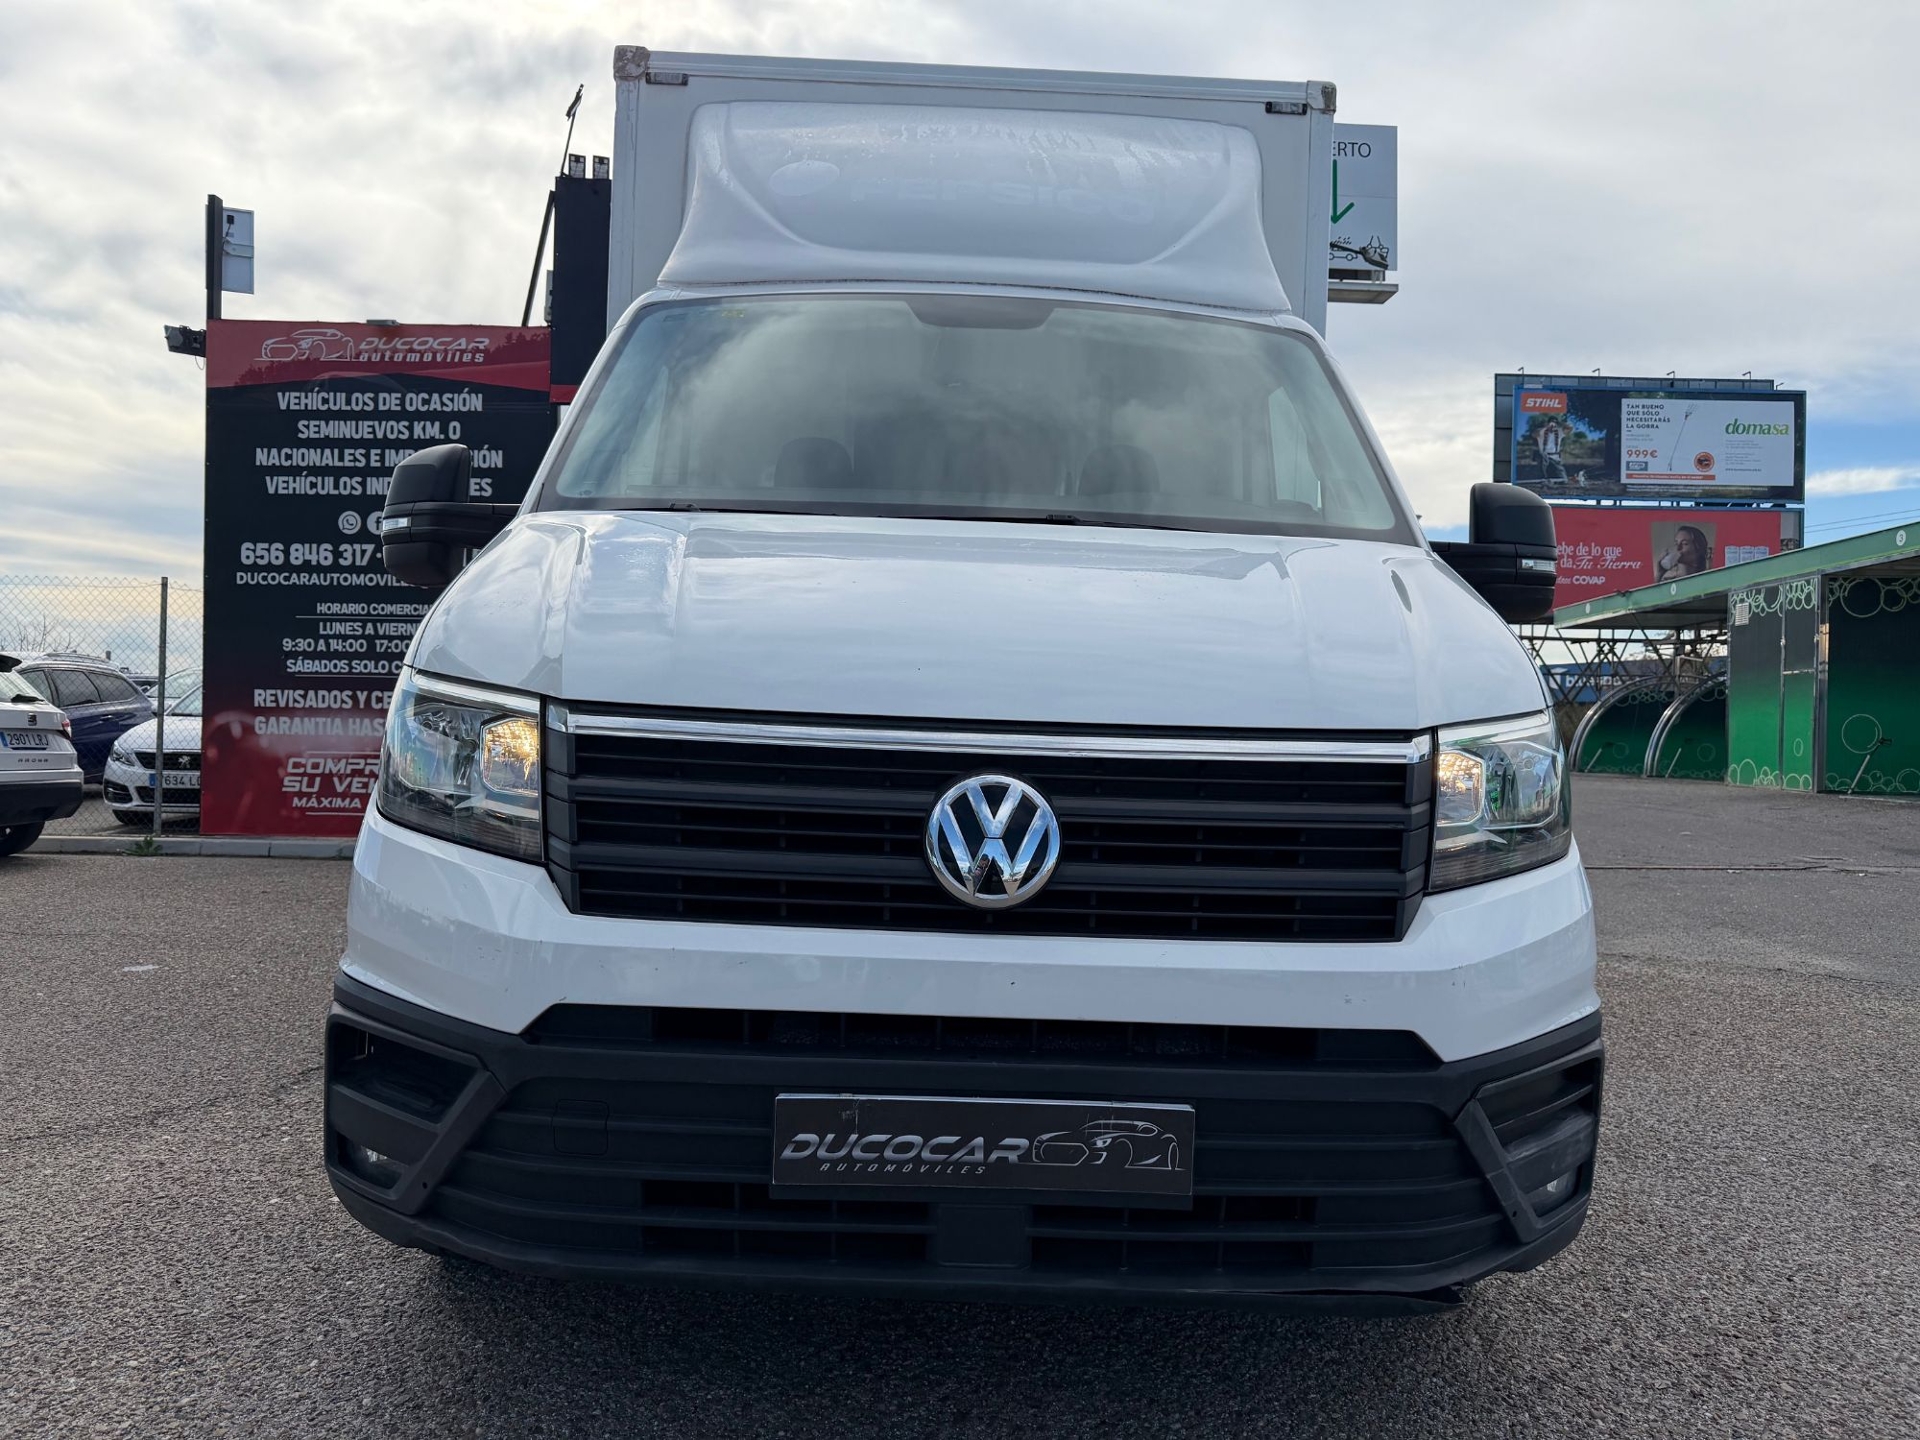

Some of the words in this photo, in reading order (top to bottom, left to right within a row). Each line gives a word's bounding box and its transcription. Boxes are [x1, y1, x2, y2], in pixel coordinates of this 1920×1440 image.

[359, 337, 490, 350] DUCOCAR
[358, 351, 485, 363] automoviles
[277, 387, 374, 412] VEHÍCULOS
[378, 392, 401, 411] DE
[404, 388, 483, 412] OCASIÓN
[1525, 397, 1562, 408] STIHL
[297, 420, 410, 440] SEMINUEVOS
[413, 421, 445, 440] KM.
[1725, 418, 1790, 435] domasa
[255, 447, 367, 468] NACIONALES
[370, 448, 381, 467] E
[1626, 449, 1658, 458] 999€
[265, 470, 362, 496] VEHÍCULOS
[240, 542, 283, 566] 656
[289, 543, 333, 567] 846
[1557, 541, 1574, 555] ebe
[1576, 542, 1589, 556] de
[1591, 542, 1601, 556] lo
[1603, 546, 1622, 558] que
[1573, 556, 1594, 569] Tu
[1597, 557, 1643, 569] Tierra
[1572, 575, 1605, 585] COVAP
[316, 603, 367, 615] HORARIO
[369, 603, 434, 616] COMERCIA
[319, 622, 362, 635] LUNES
[364, 623, 374, 635] A
[282, 639, 314, 652] 9:30
[316, 639, 326, 652] A
[329, 639, 367, 652] 14:00
[286, 657, 349, 673] SÁBADOS
[352, 660, 389, 674] SOLO
[254, 689, 355, 709] REVISADOS
[357, 690, 369, 709] Y
[254, 716, 346, 736] GARANTIA
[7, 733, 32, 745] 2901
[32, 733, 49, 746] LRJ
[282, 777, 322, 793] SU
[292, 795, 362, 809] MÁXIMA
[780, 1133, 1031, 1165] DUCOCAR
[819, 1162, 986, 1175] AUTOMÓVILES
